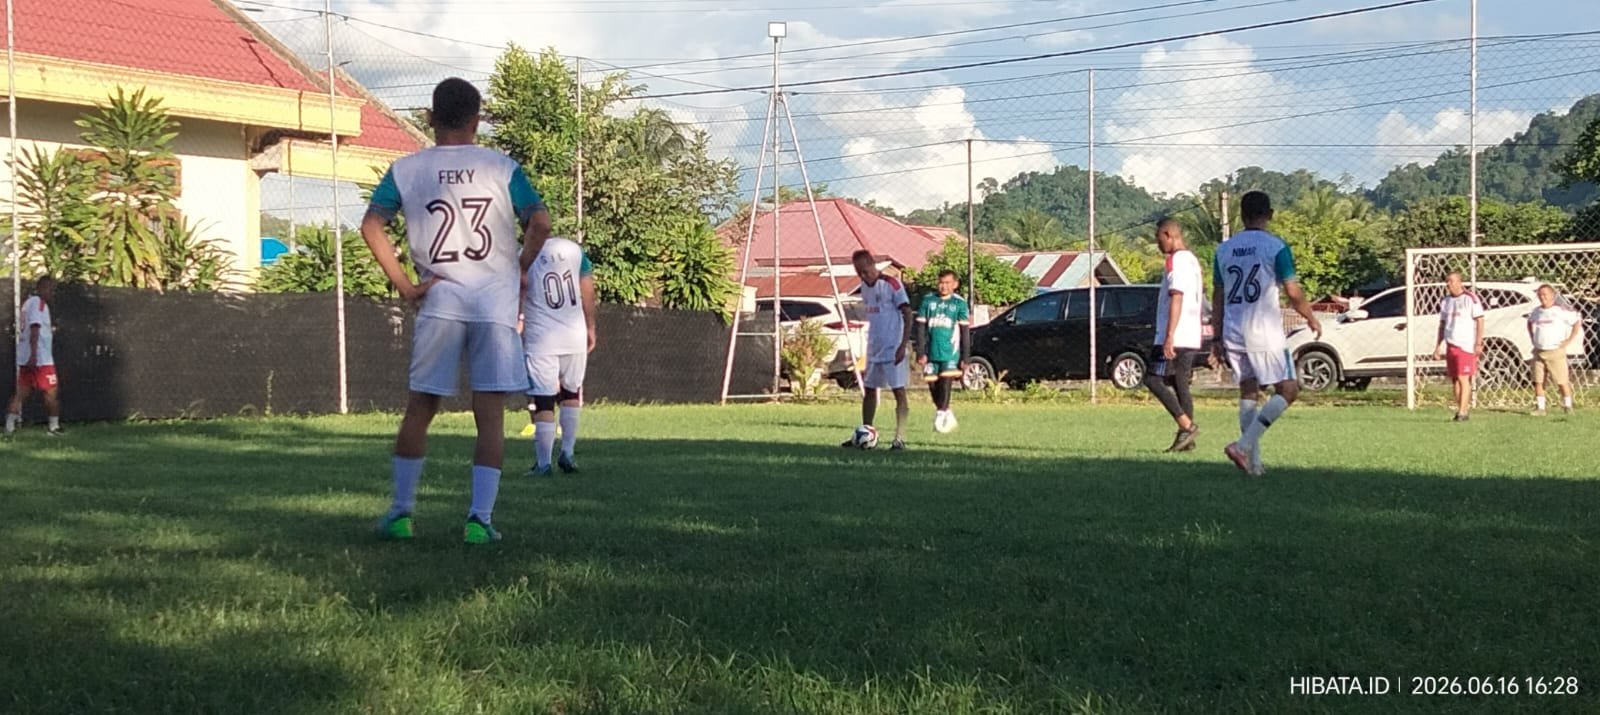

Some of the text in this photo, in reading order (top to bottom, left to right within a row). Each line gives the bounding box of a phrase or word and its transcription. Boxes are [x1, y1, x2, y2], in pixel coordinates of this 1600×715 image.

[438, 169, 475, 184] FEKY
[425, 198, 493, 264] 23
[543, 270, 577, 310] 01
[1227, 263, 1261, 304] 26
